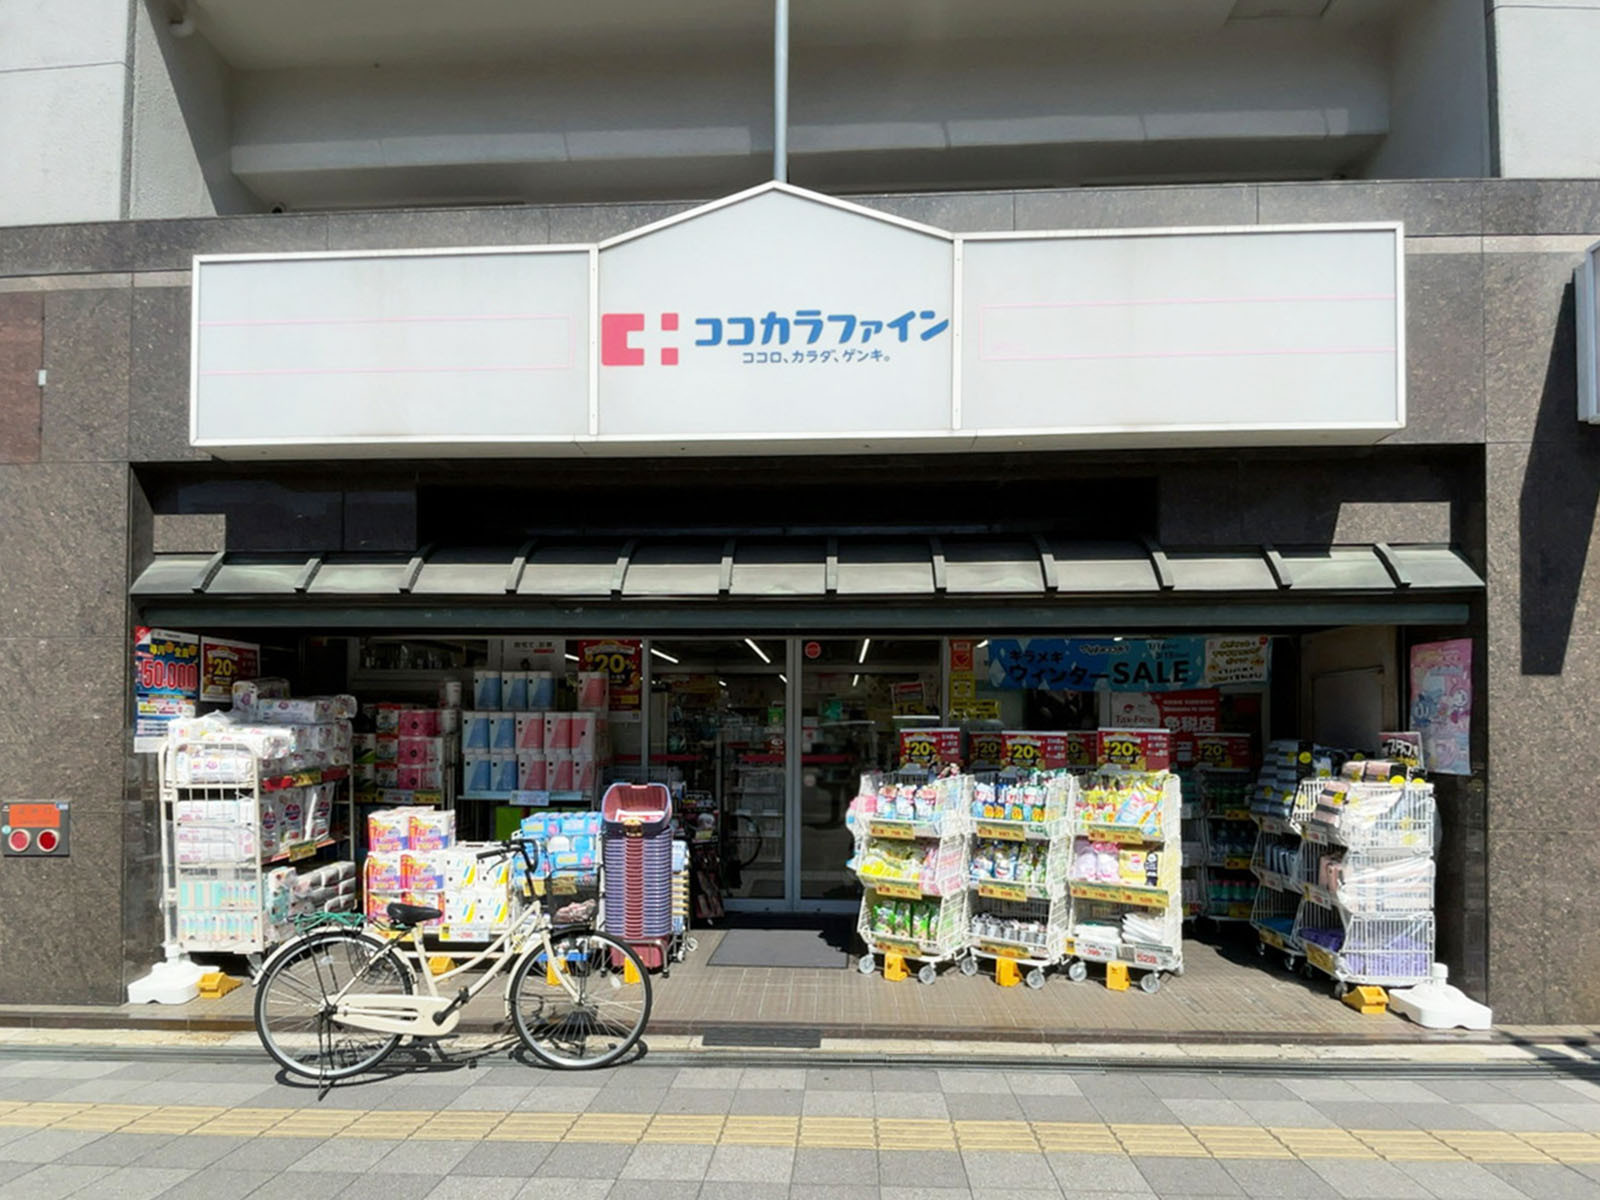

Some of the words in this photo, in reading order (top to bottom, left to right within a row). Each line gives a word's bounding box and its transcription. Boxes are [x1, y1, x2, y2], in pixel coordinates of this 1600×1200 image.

[695, 310, 949, 347] ココカラファイン
[742, 348, 890, 364] ココロ、カラダ、ゲンキ。
[1009, 650, 1064, 663] キラメキ
